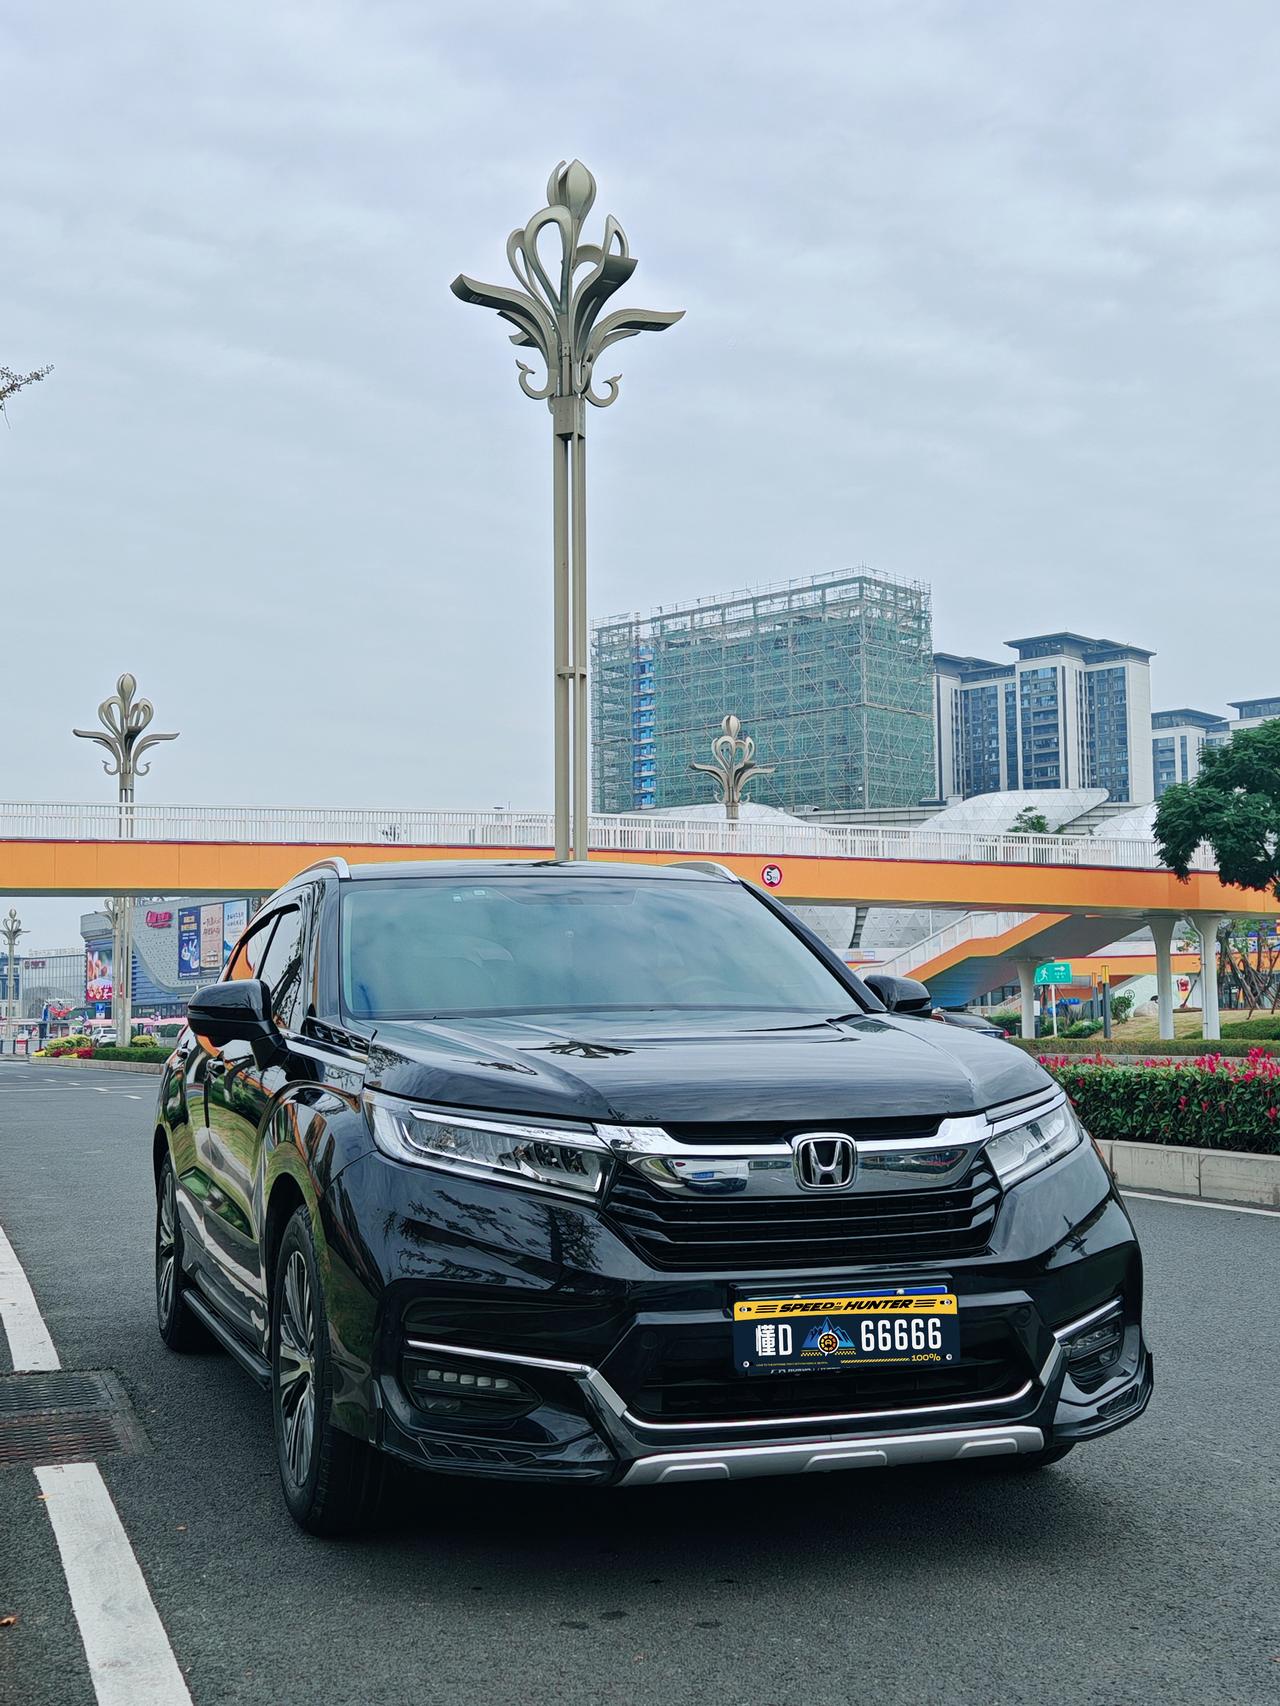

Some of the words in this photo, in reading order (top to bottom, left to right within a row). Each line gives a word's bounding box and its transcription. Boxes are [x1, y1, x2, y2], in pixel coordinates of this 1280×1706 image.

[779, 1301, 835, 1313] SPEED
[843, 1299, 914, 1311] HUNTER
[860, 1317, 942, 1352] 66666
[911, 1353, 941, 1362] 100%
